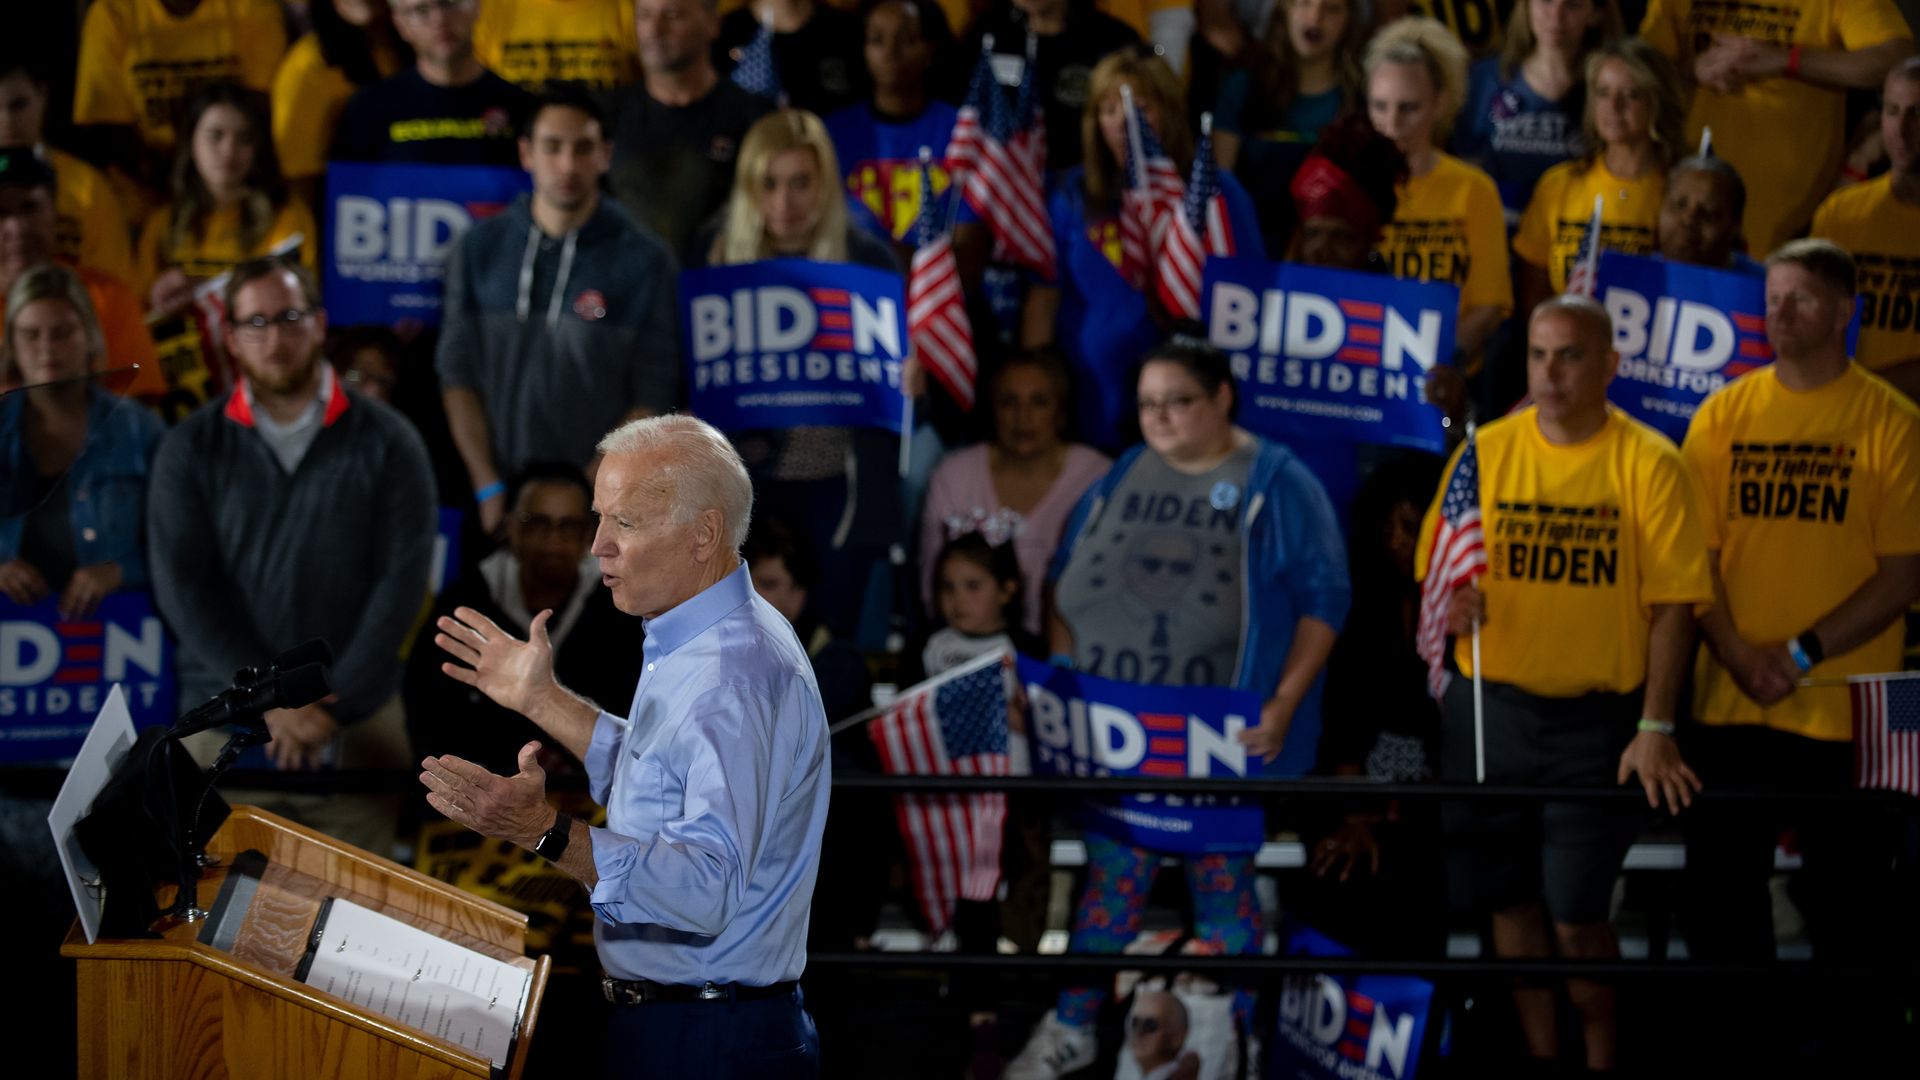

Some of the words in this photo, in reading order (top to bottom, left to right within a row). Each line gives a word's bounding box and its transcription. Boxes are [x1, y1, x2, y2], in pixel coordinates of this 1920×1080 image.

[334, 194, 506, 262] BID
[1385, 250, 1470, 282] IDEN
[689, 284, 903, 363] BIDEN
[1208, 279, 1443, 372] BIDEN
[1602, 285, 1776, 373] BIDE
[1861, 293, 1920, 331] BID
[694, 352, 903, 392] PRESIDENT
[1229, 351, 1428, 406] RESIDENT
[1616, 356, 1676, 389] ORKS
[1121, 492, 1242, 534] BIDEN
[1740, 481, 1849, 525] BIDEN
[1508, 542, 1618, 587] BIDEN
[0, 615, 164, 687] DEN
[1087, 645, 1214, 687] 2020
[1026, 681, 1247, 779] BIDEN
